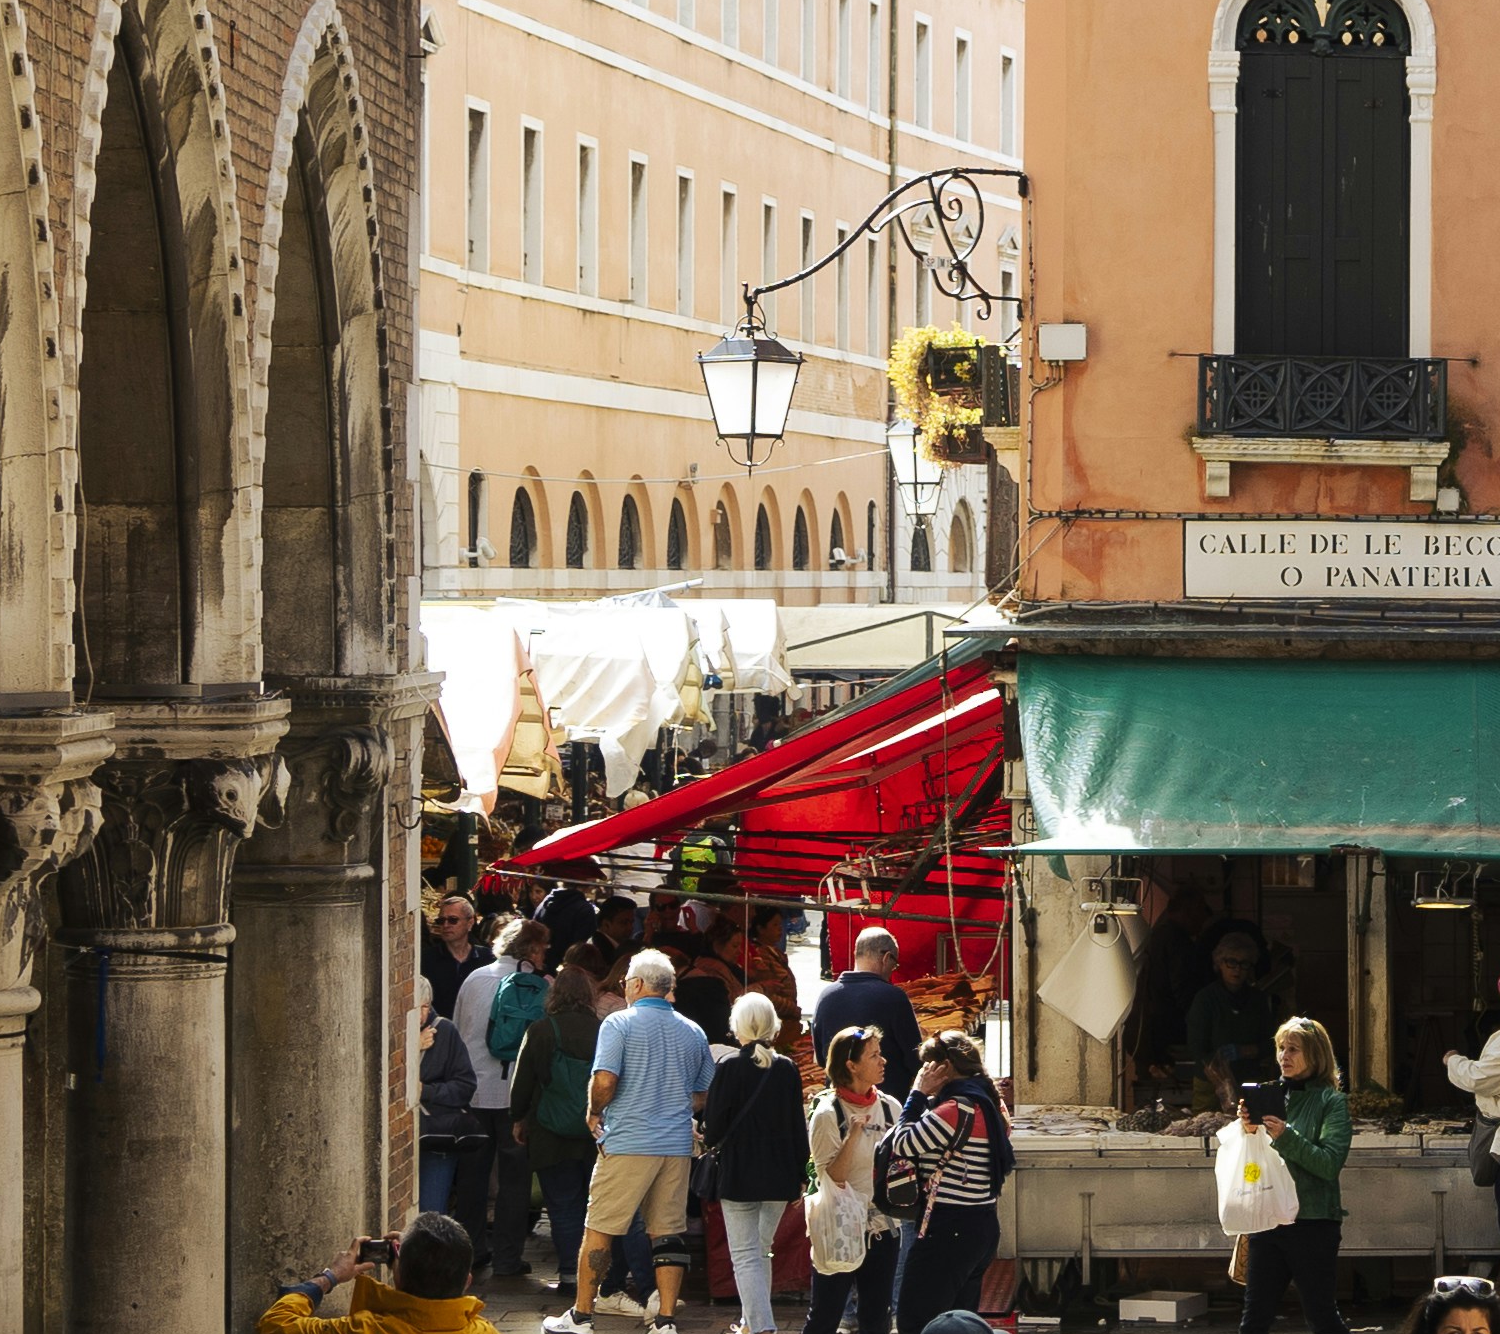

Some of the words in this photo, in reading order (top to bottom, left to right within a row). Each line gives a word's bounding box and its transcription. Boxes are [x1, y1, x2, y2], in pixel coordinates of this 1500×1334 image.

[1199, 534, 1296, 554] CALLE
[1310, 534, 1348, 554] DE
[1365, 534, 1401, 555] LE
[1280, 566, 1303, 587] O
[1325, 566, 1493, 587] PANATERIA
